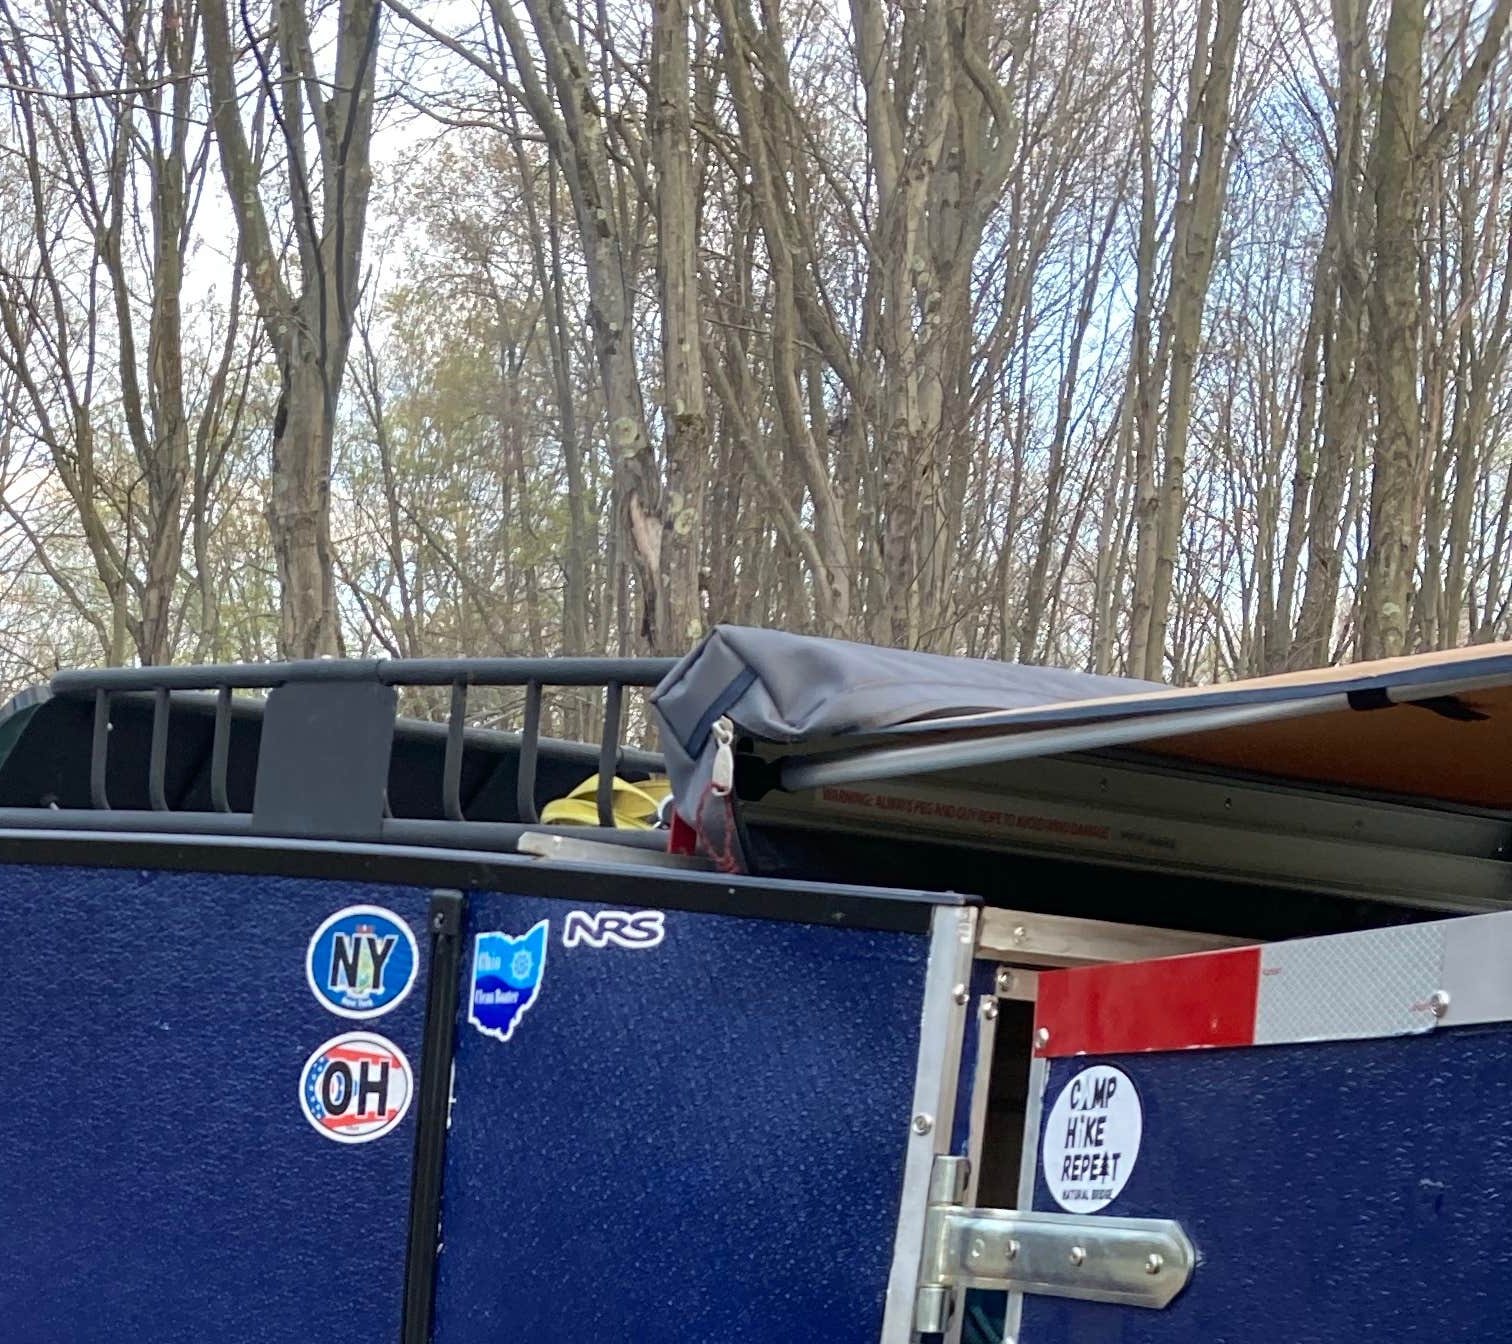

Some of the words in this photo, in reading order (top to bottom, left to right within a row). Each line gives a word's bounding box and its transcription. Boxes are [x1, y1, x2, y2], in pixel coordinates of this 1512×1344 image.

[566, 916, 660, 943] NRS
[329, 935, 396, 989] NY
[321, 1060, 390, 1116] OH
[1061, 1152, 1121, 1184] REPEAT
